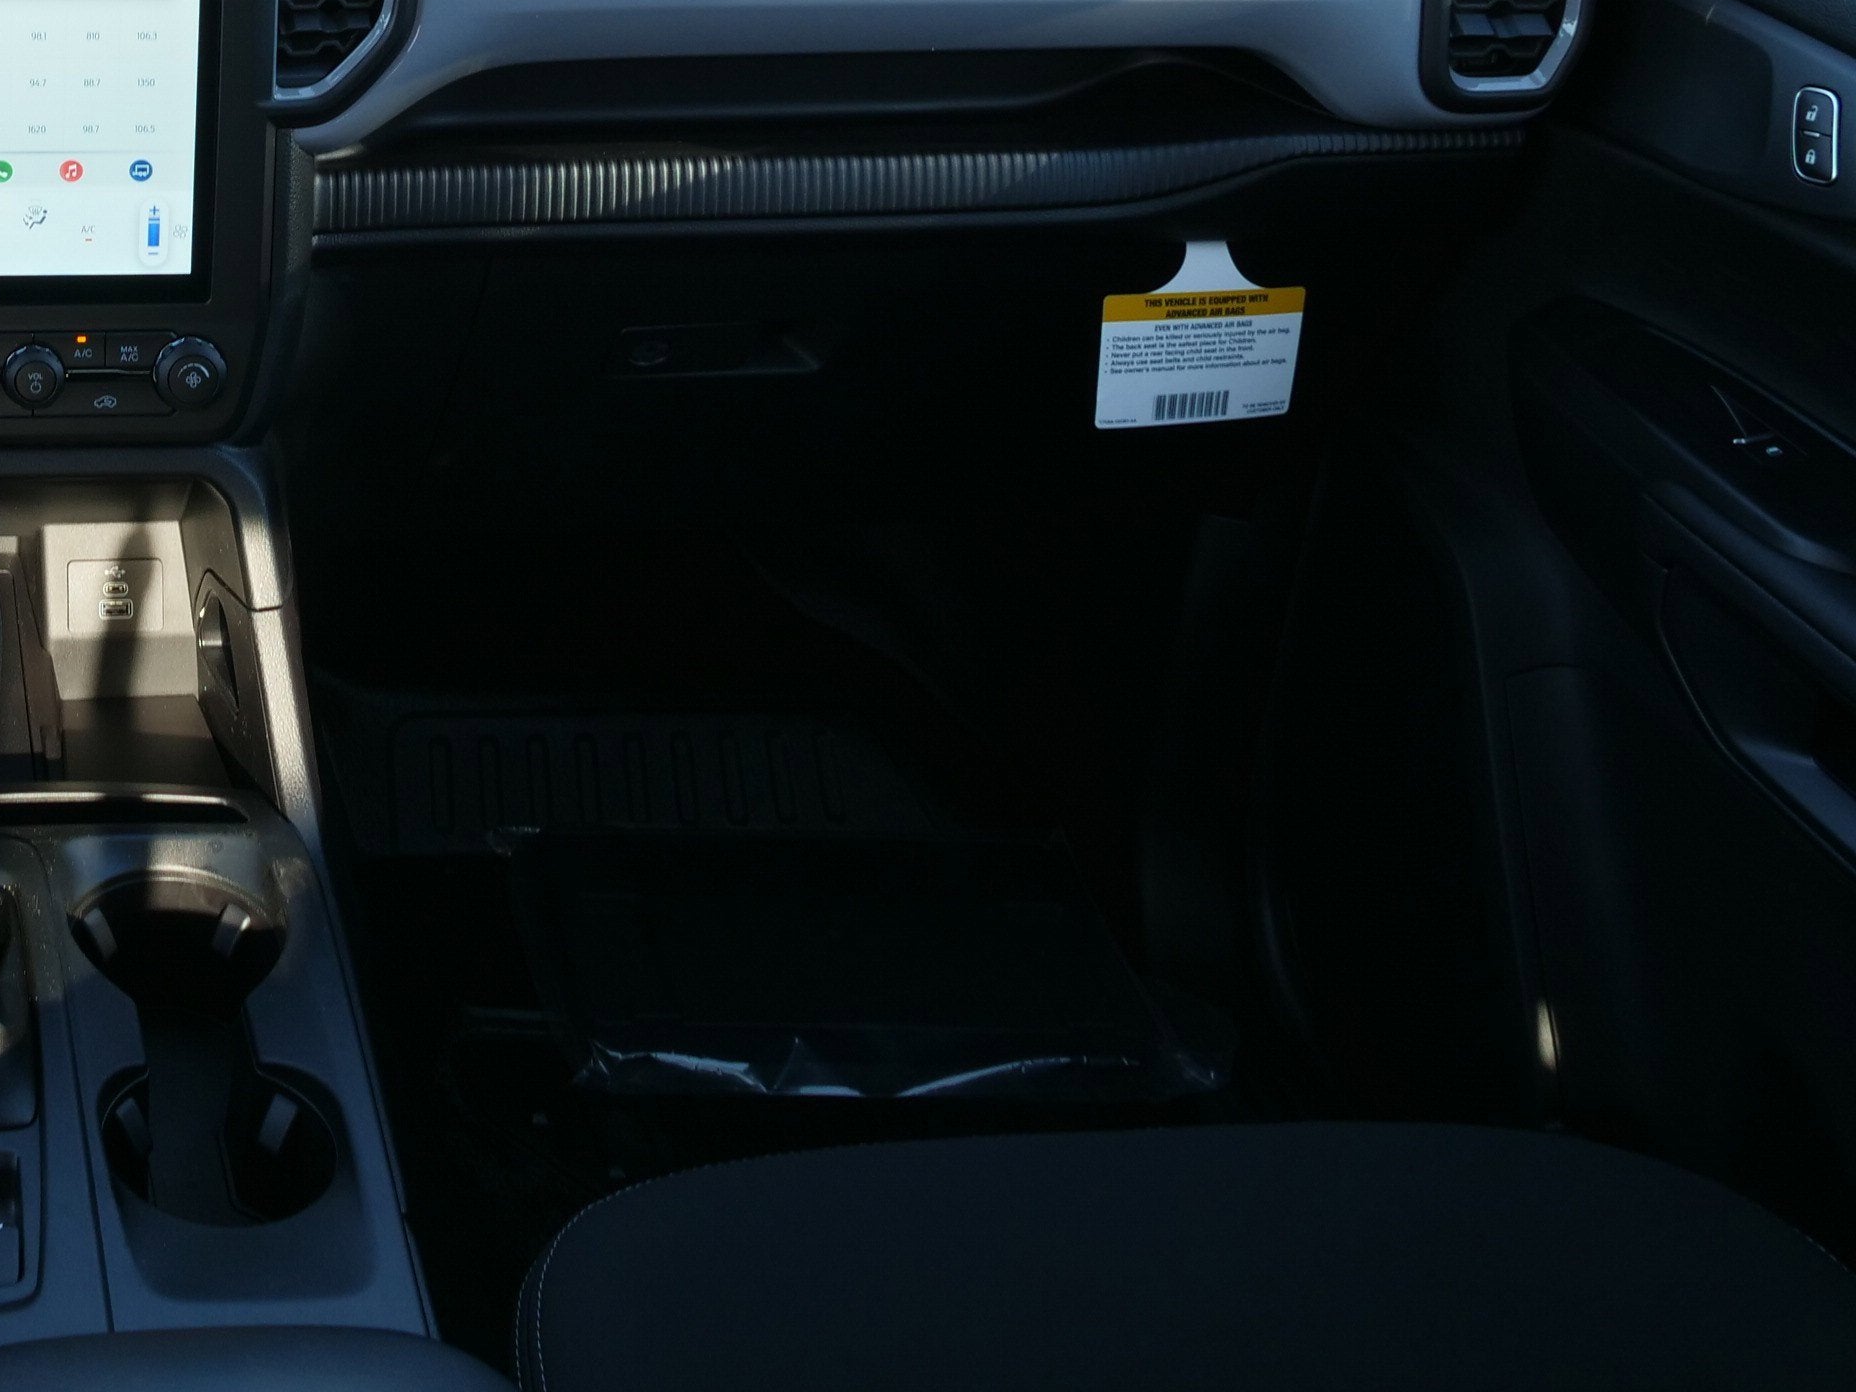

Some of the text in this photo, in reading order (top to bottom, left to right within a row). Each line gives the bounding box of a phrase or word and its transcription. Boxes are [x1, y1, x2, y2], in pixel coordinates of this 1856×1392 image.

[1145, 294, 1269, 308] THIS VEHICLE IS EQUIPPED WITH
[1165, 306, 1246, 318] ADVANCED AIR BAGS
[1155, 324, 1171, 332] EVEN
[1190, 321, 1223, 330] ADVANCED
[1236, 319, 1252, 327] BAGS
[1112, 335, 1141, 343] Children
[1199, 339, 1216, 347] place
[73, 348, 92, 358] A/C
[120, 352, 139, 362] A/C
[1132, 351, 1143, 359] put
[1110, 359, 1134, 367] Always
[28, 372, 44, 381] VOL
